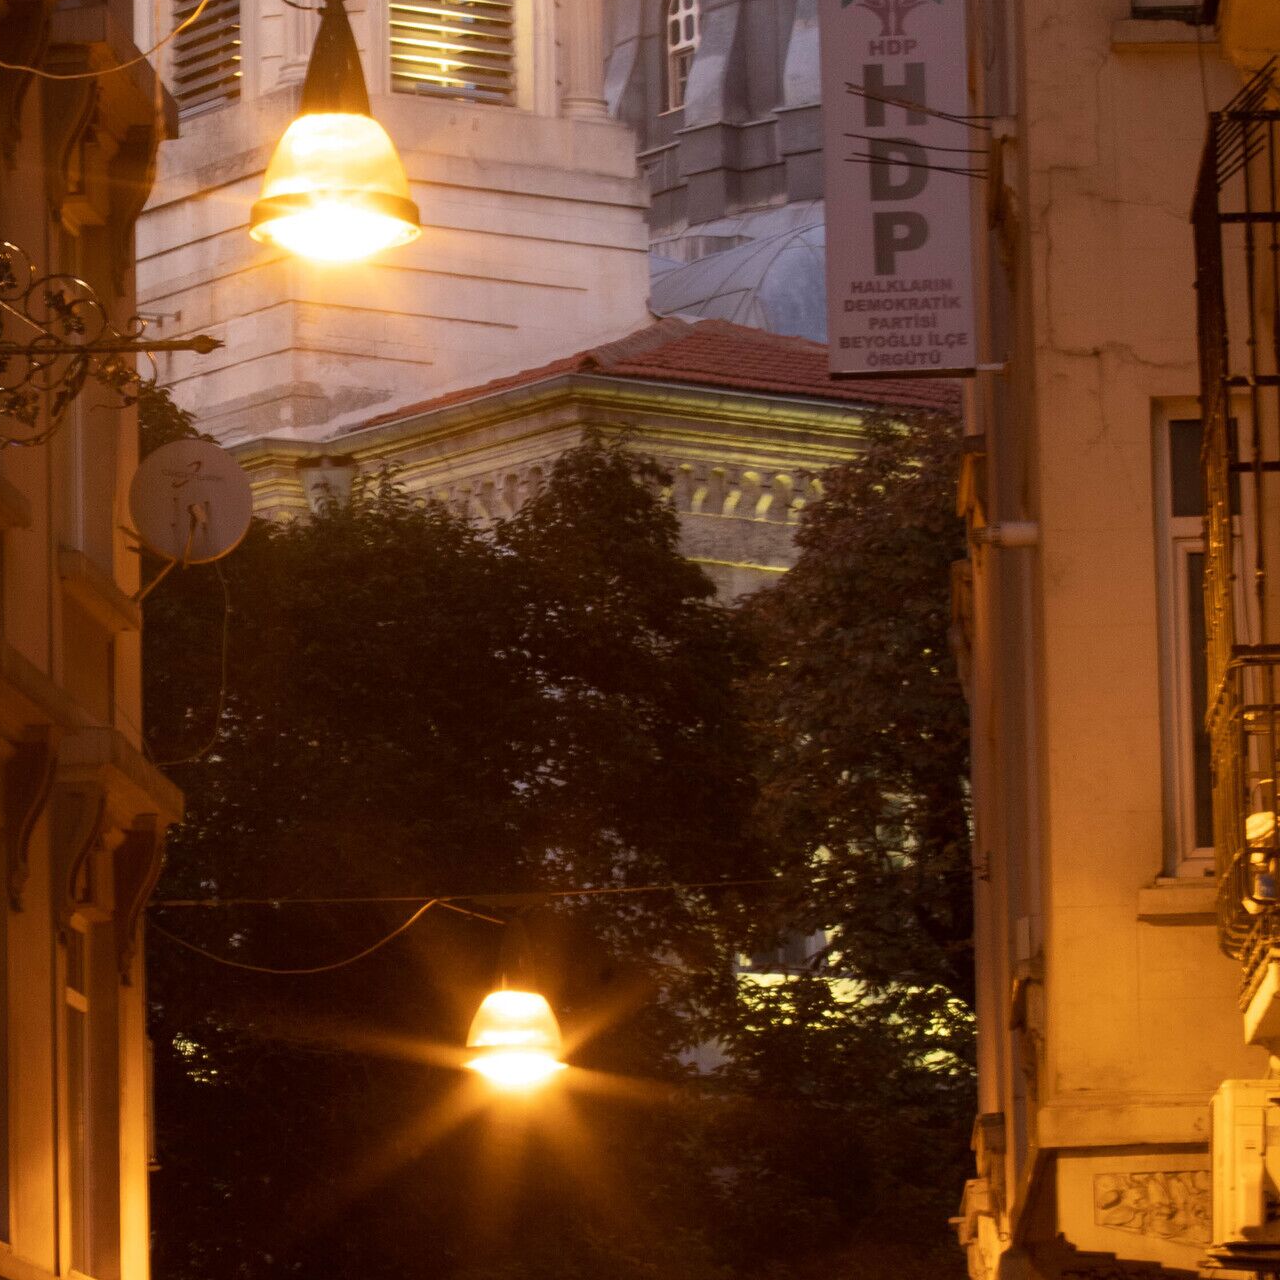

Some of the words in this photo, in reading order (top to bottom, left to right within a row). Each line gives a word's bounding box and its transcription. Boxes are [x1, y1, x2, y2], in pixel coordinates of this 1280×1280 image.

[869, 39, 918, 56] HDP
[862, 62, 929, 275] HDP
[851, 278, 952, 294] HALKLARIN
[844, 294, 961, 312] DEMOKRATİK
[868, 313, 937, 330] PARTİSİ
[839, 332, 922, 349] BEYOĞLU
[928, 330, 967, 348] İLÇE
[867, 349, 941, 366] ÖRGÜTÜ
